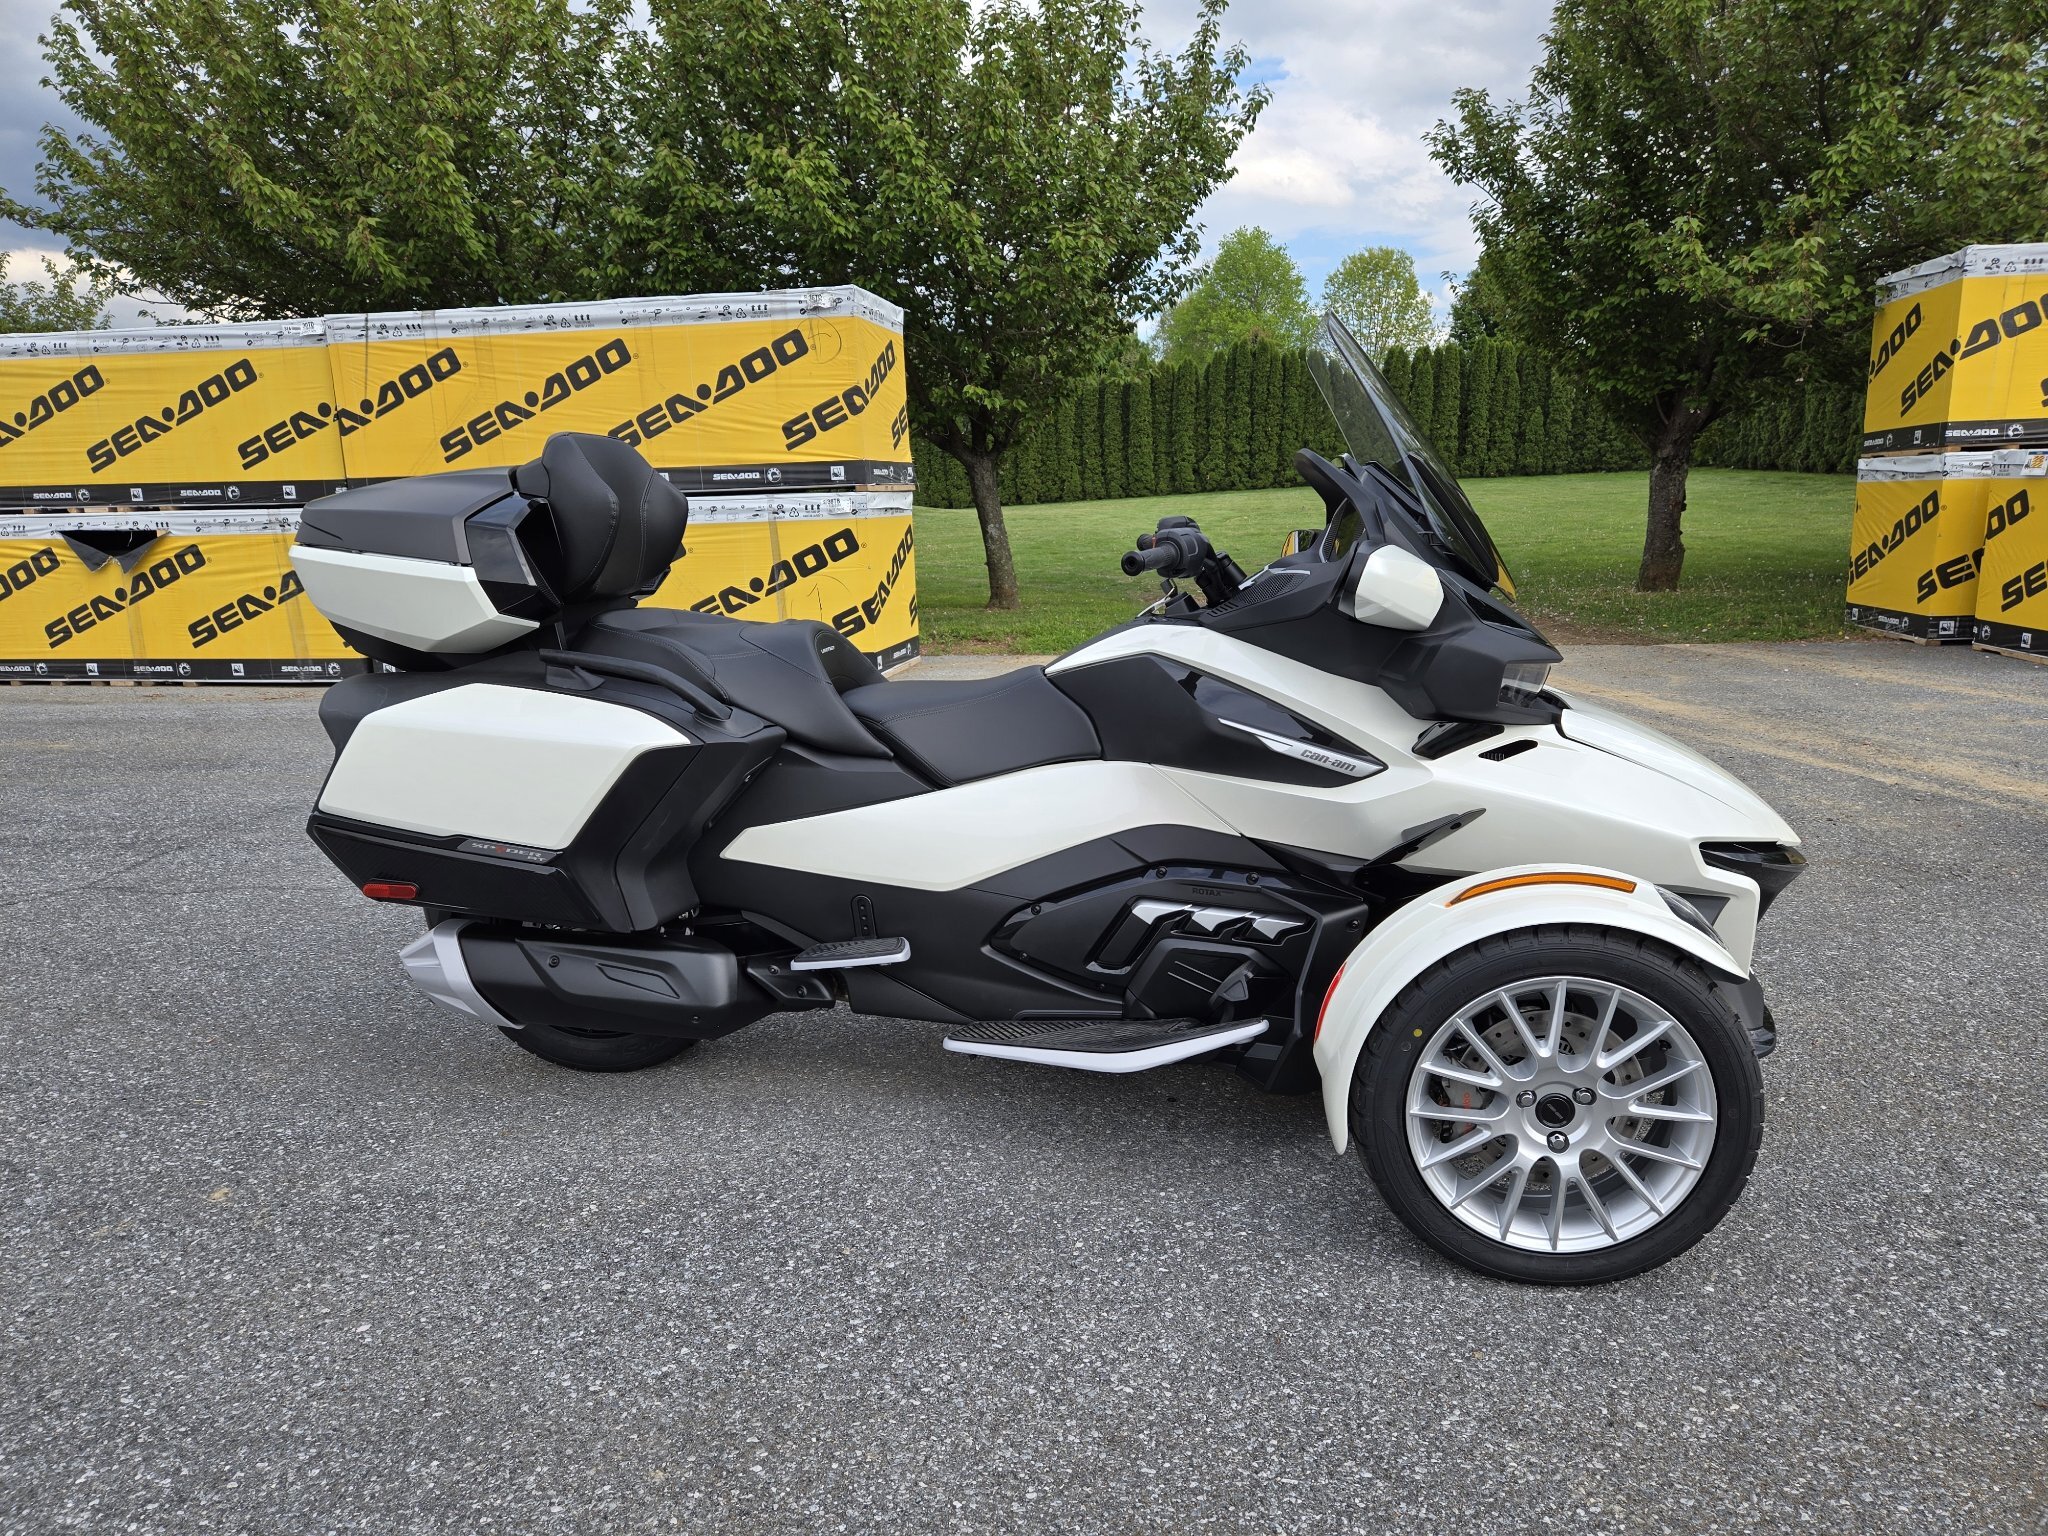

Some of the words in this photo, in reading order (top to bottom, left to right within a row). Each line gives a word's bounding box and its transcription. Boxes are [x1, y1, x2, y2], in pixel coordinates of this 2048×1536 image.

[440, 338, 631, 463] SEA•DOO
[782, 339, 895, 451] SEA•DOO
[1901, 293, 2048, 418] SEA•DO
[86, 358, 258, 474] SEA•DOO
[44, 543, 206, 649] SEA•DOO
[689, 527, 860, 615] EA•DOO
[1301, 749, 1357, 771] can-am
[1192, 887, 1222, 897] ROTAX
